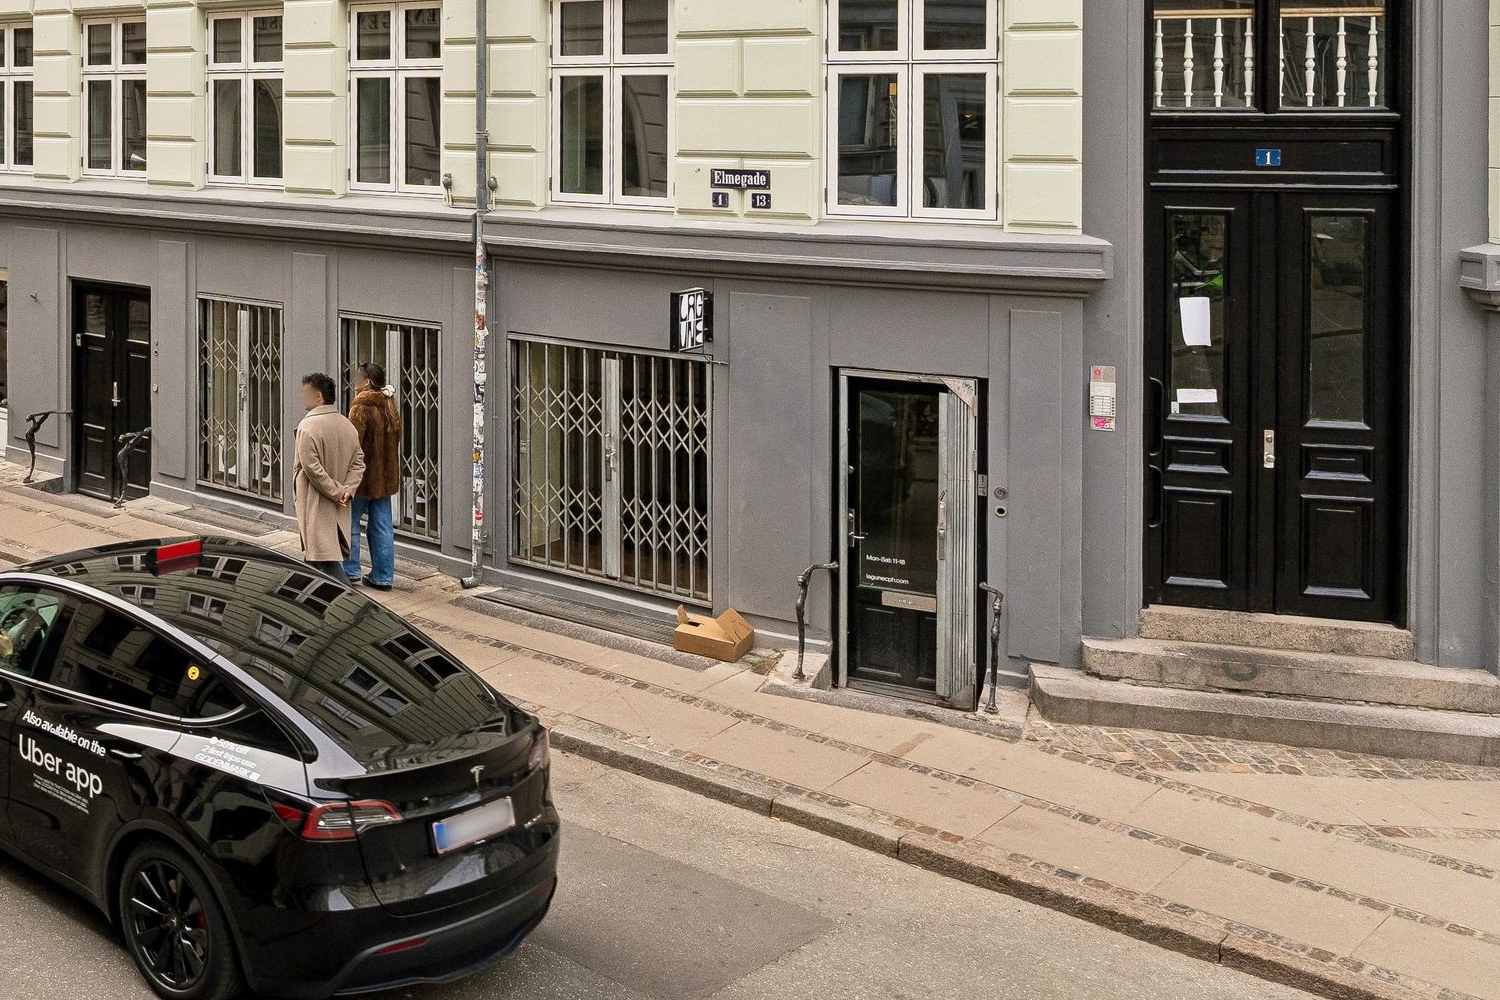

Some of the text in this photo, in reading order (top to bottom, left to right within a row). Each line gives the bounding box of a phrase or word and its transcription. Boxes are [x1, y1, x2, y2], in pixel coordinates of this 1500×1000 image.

[1266, 151, 1271, 165] 1
[714, 170, 766, 188] Elmegade
[718, 194, 766, 207] 1 13
[865, 573, 909, 585] lagunecph.com
[22, 710, 42, 727] Also
[77, 736, 90, 750] on
[90, 740, 106, 757] the
[19, 733, 62, 775] Uber
[65, 762, 103, 798] app
